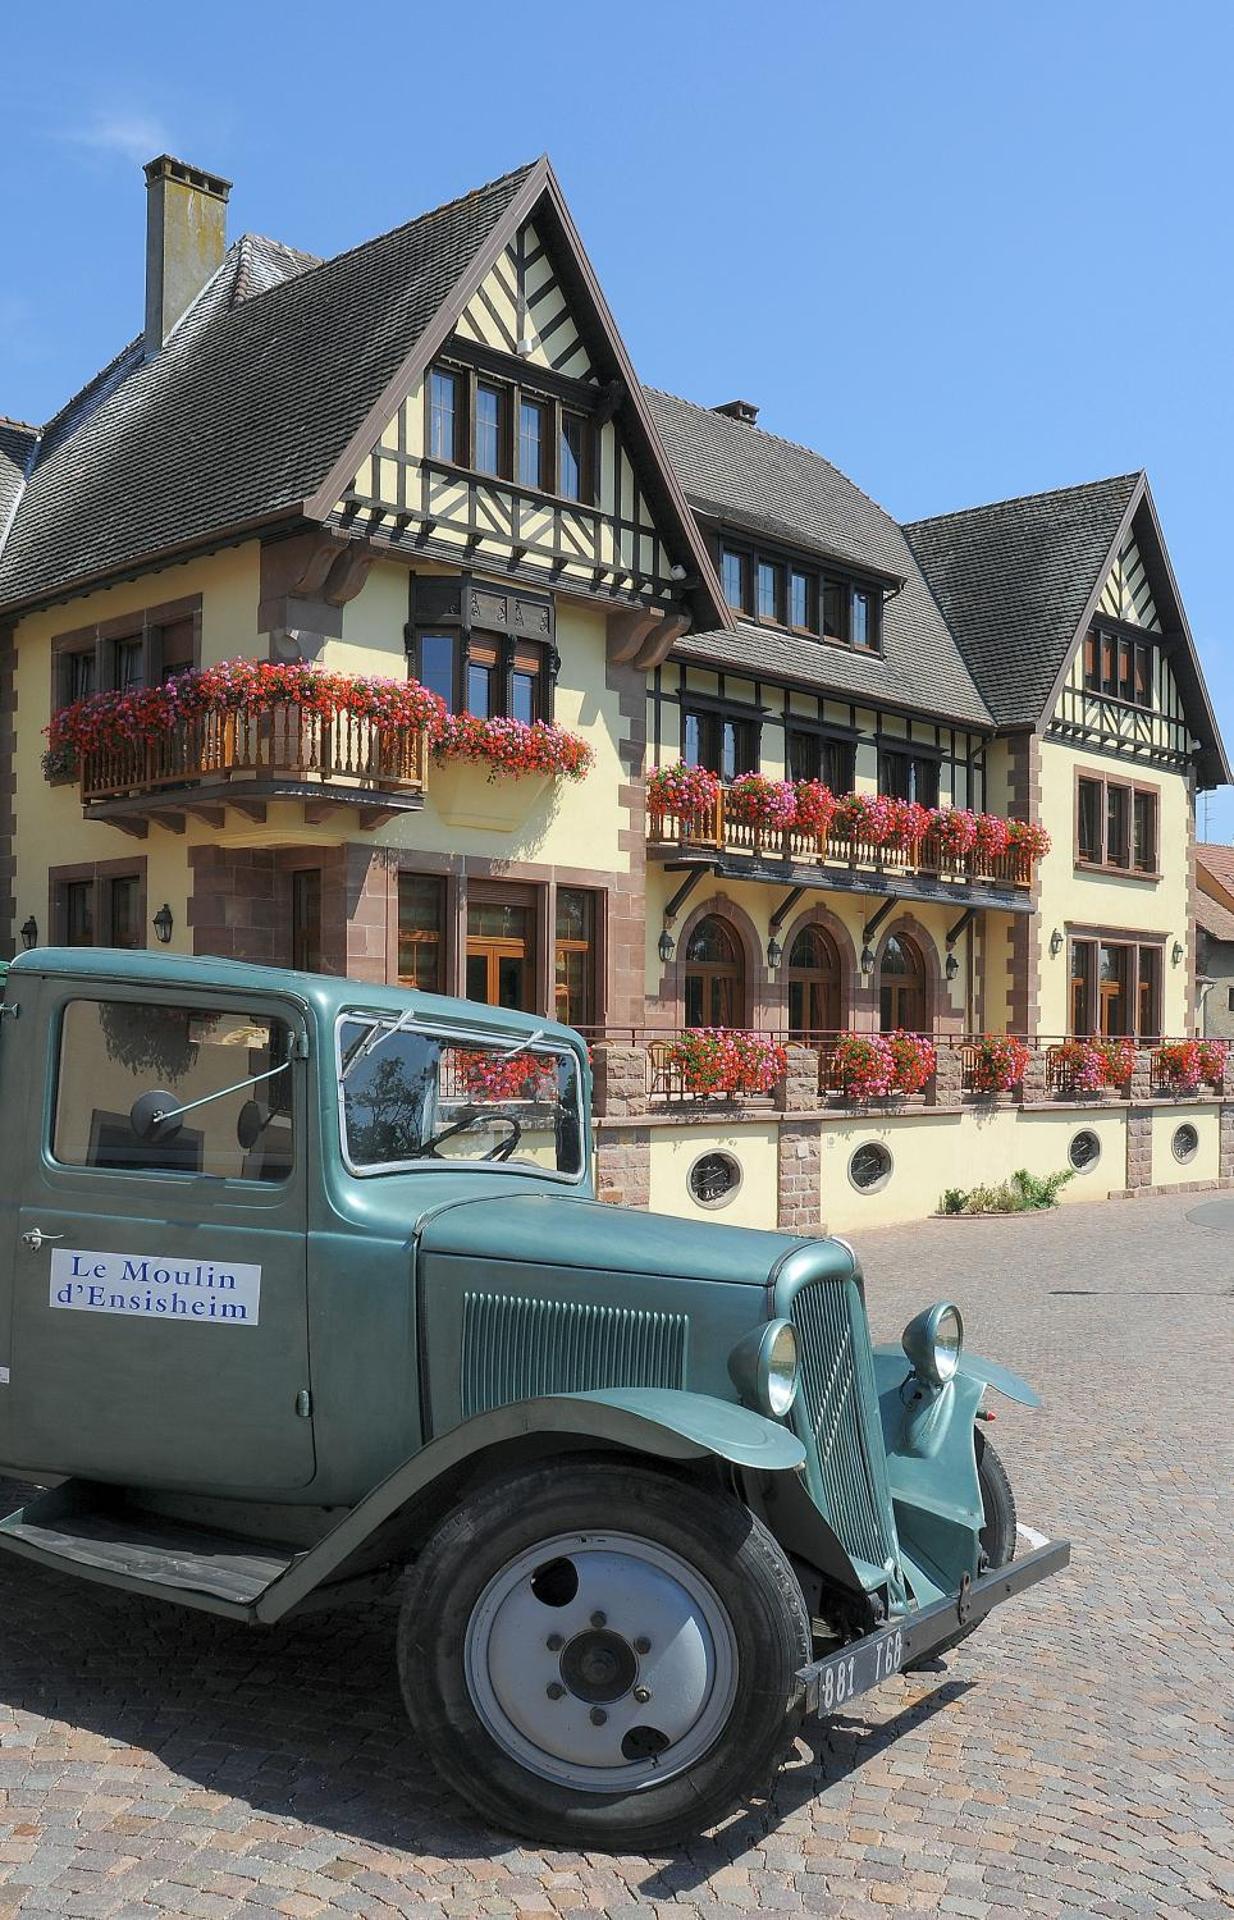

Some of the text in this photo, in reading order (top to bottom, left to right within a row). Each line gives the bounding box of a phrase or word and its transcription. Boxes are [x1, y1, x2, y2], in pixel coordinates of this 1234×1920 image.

[71, 1256, 237, 1290] Le Moulin
[57, 1283, 249, 1319] d'Ensisheim
[823, 1656, 855, 1709] 881
